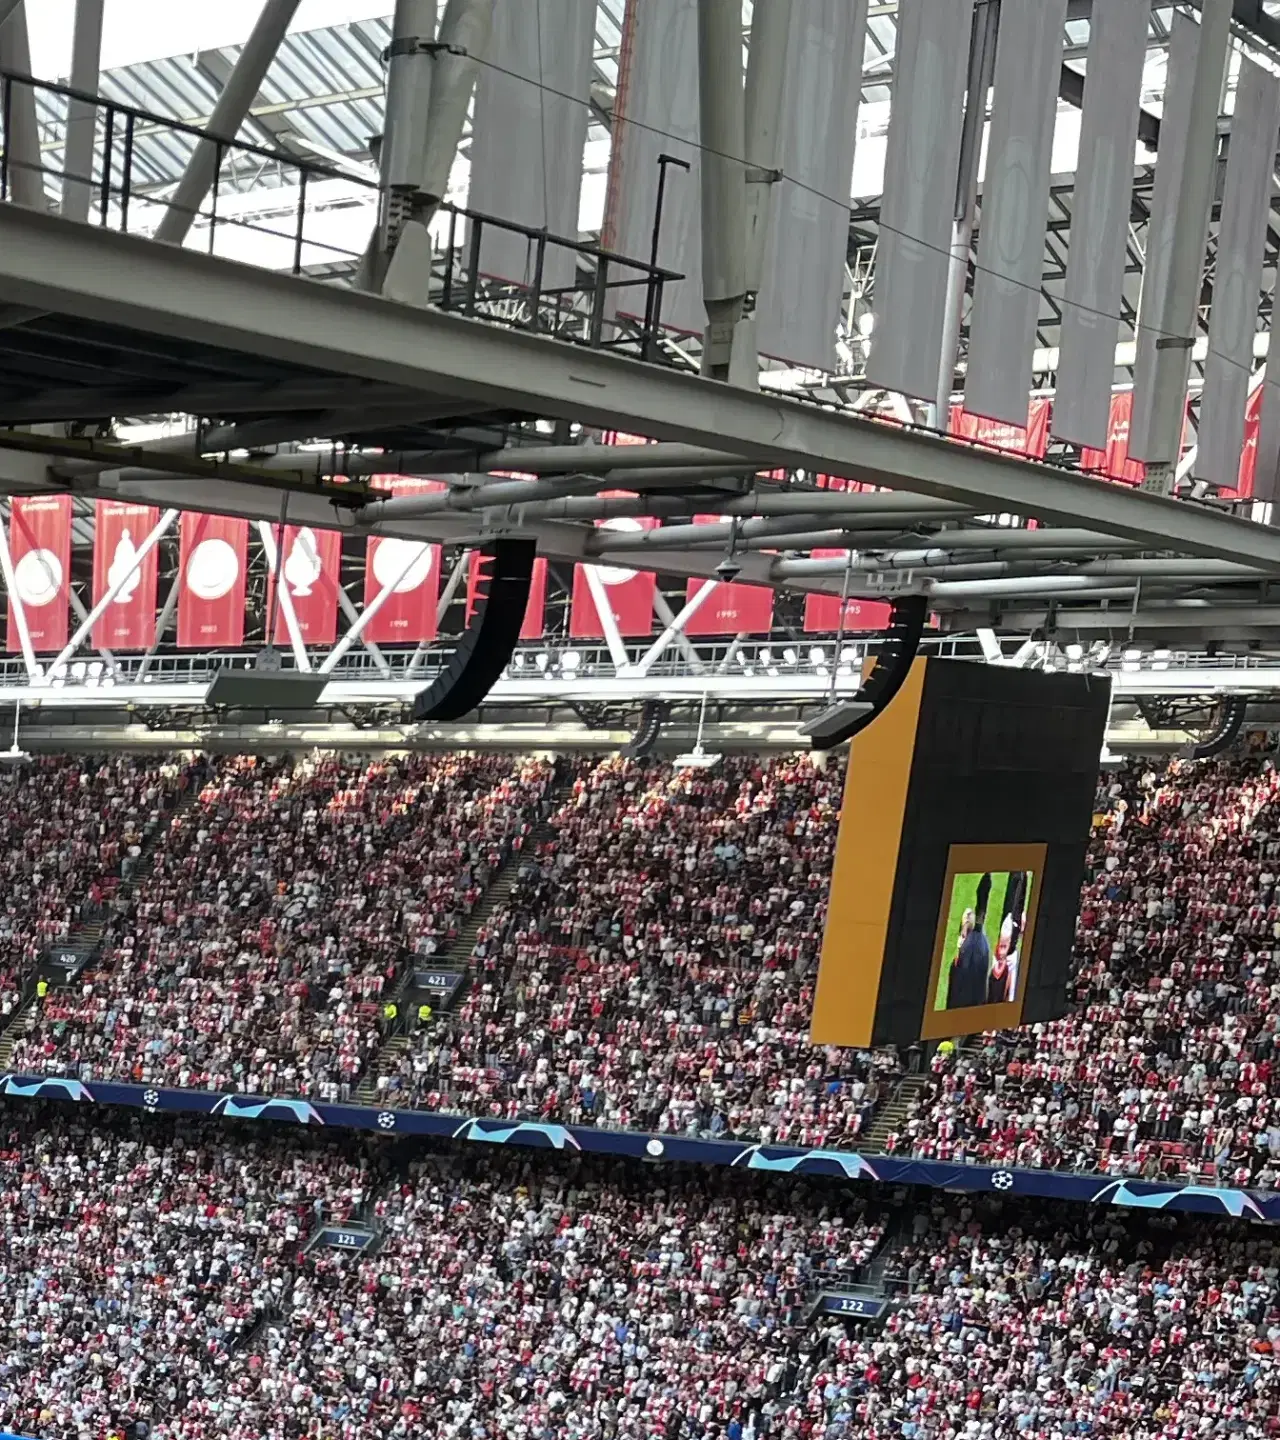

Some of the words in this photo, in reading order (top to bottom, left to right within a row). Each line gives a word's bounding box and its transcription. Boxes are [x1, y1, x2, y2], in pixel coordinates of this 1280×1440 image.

[428, 976, 446, 986] 421
[338, 1234, 355, 1244] 121
[841, 1301, 864, 1312] 122
